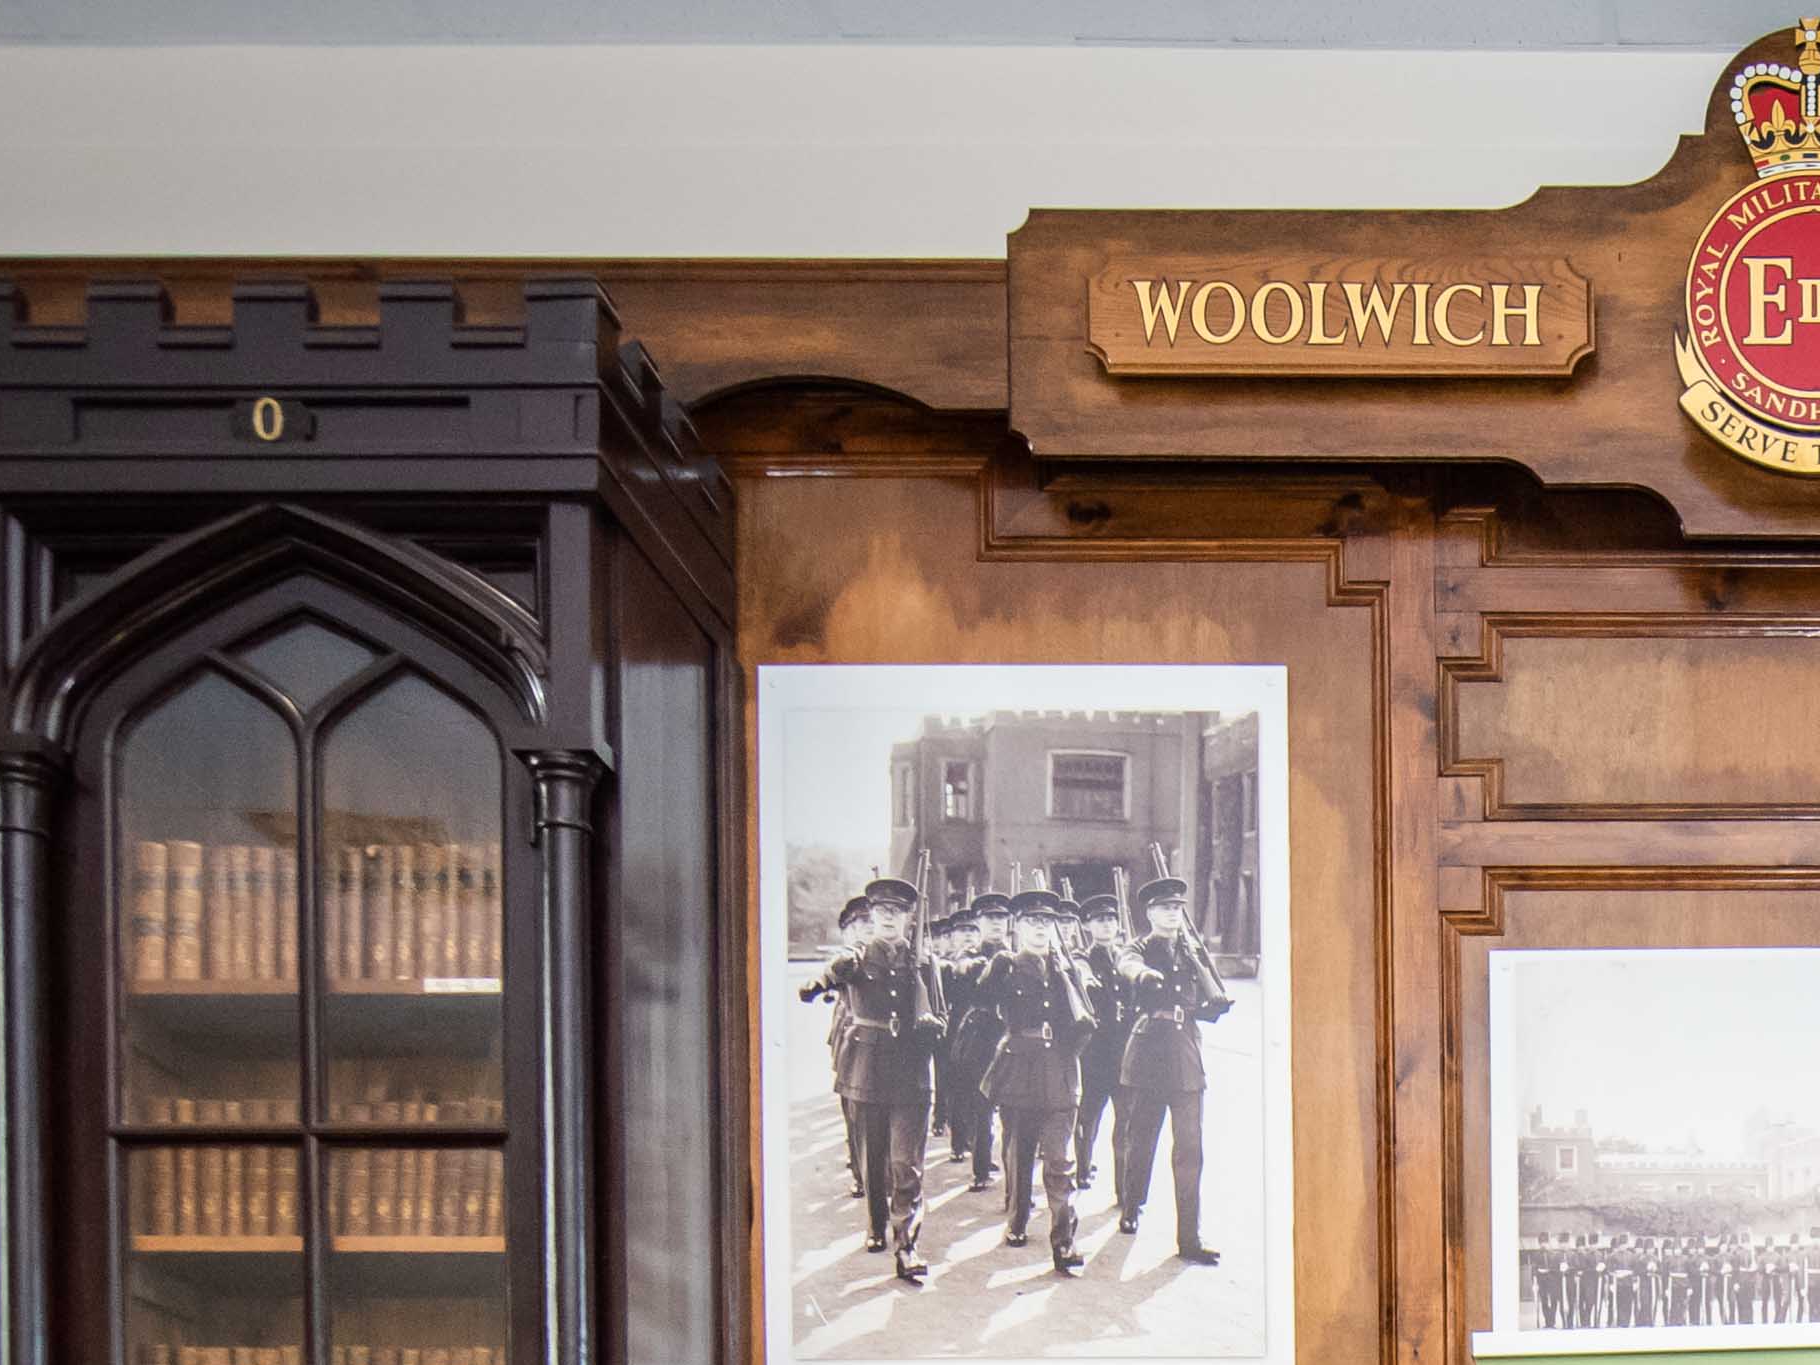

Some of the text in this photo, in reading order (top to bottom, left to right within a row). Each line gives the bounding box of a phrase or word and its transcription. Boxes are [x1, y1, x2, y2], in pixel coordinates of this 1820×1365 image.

[1130, 278, 1544, 348] WOOLWICH
[1694, 242, 1729, 348] ROYAL
[1701, 400, 1799, 464] SERVE
